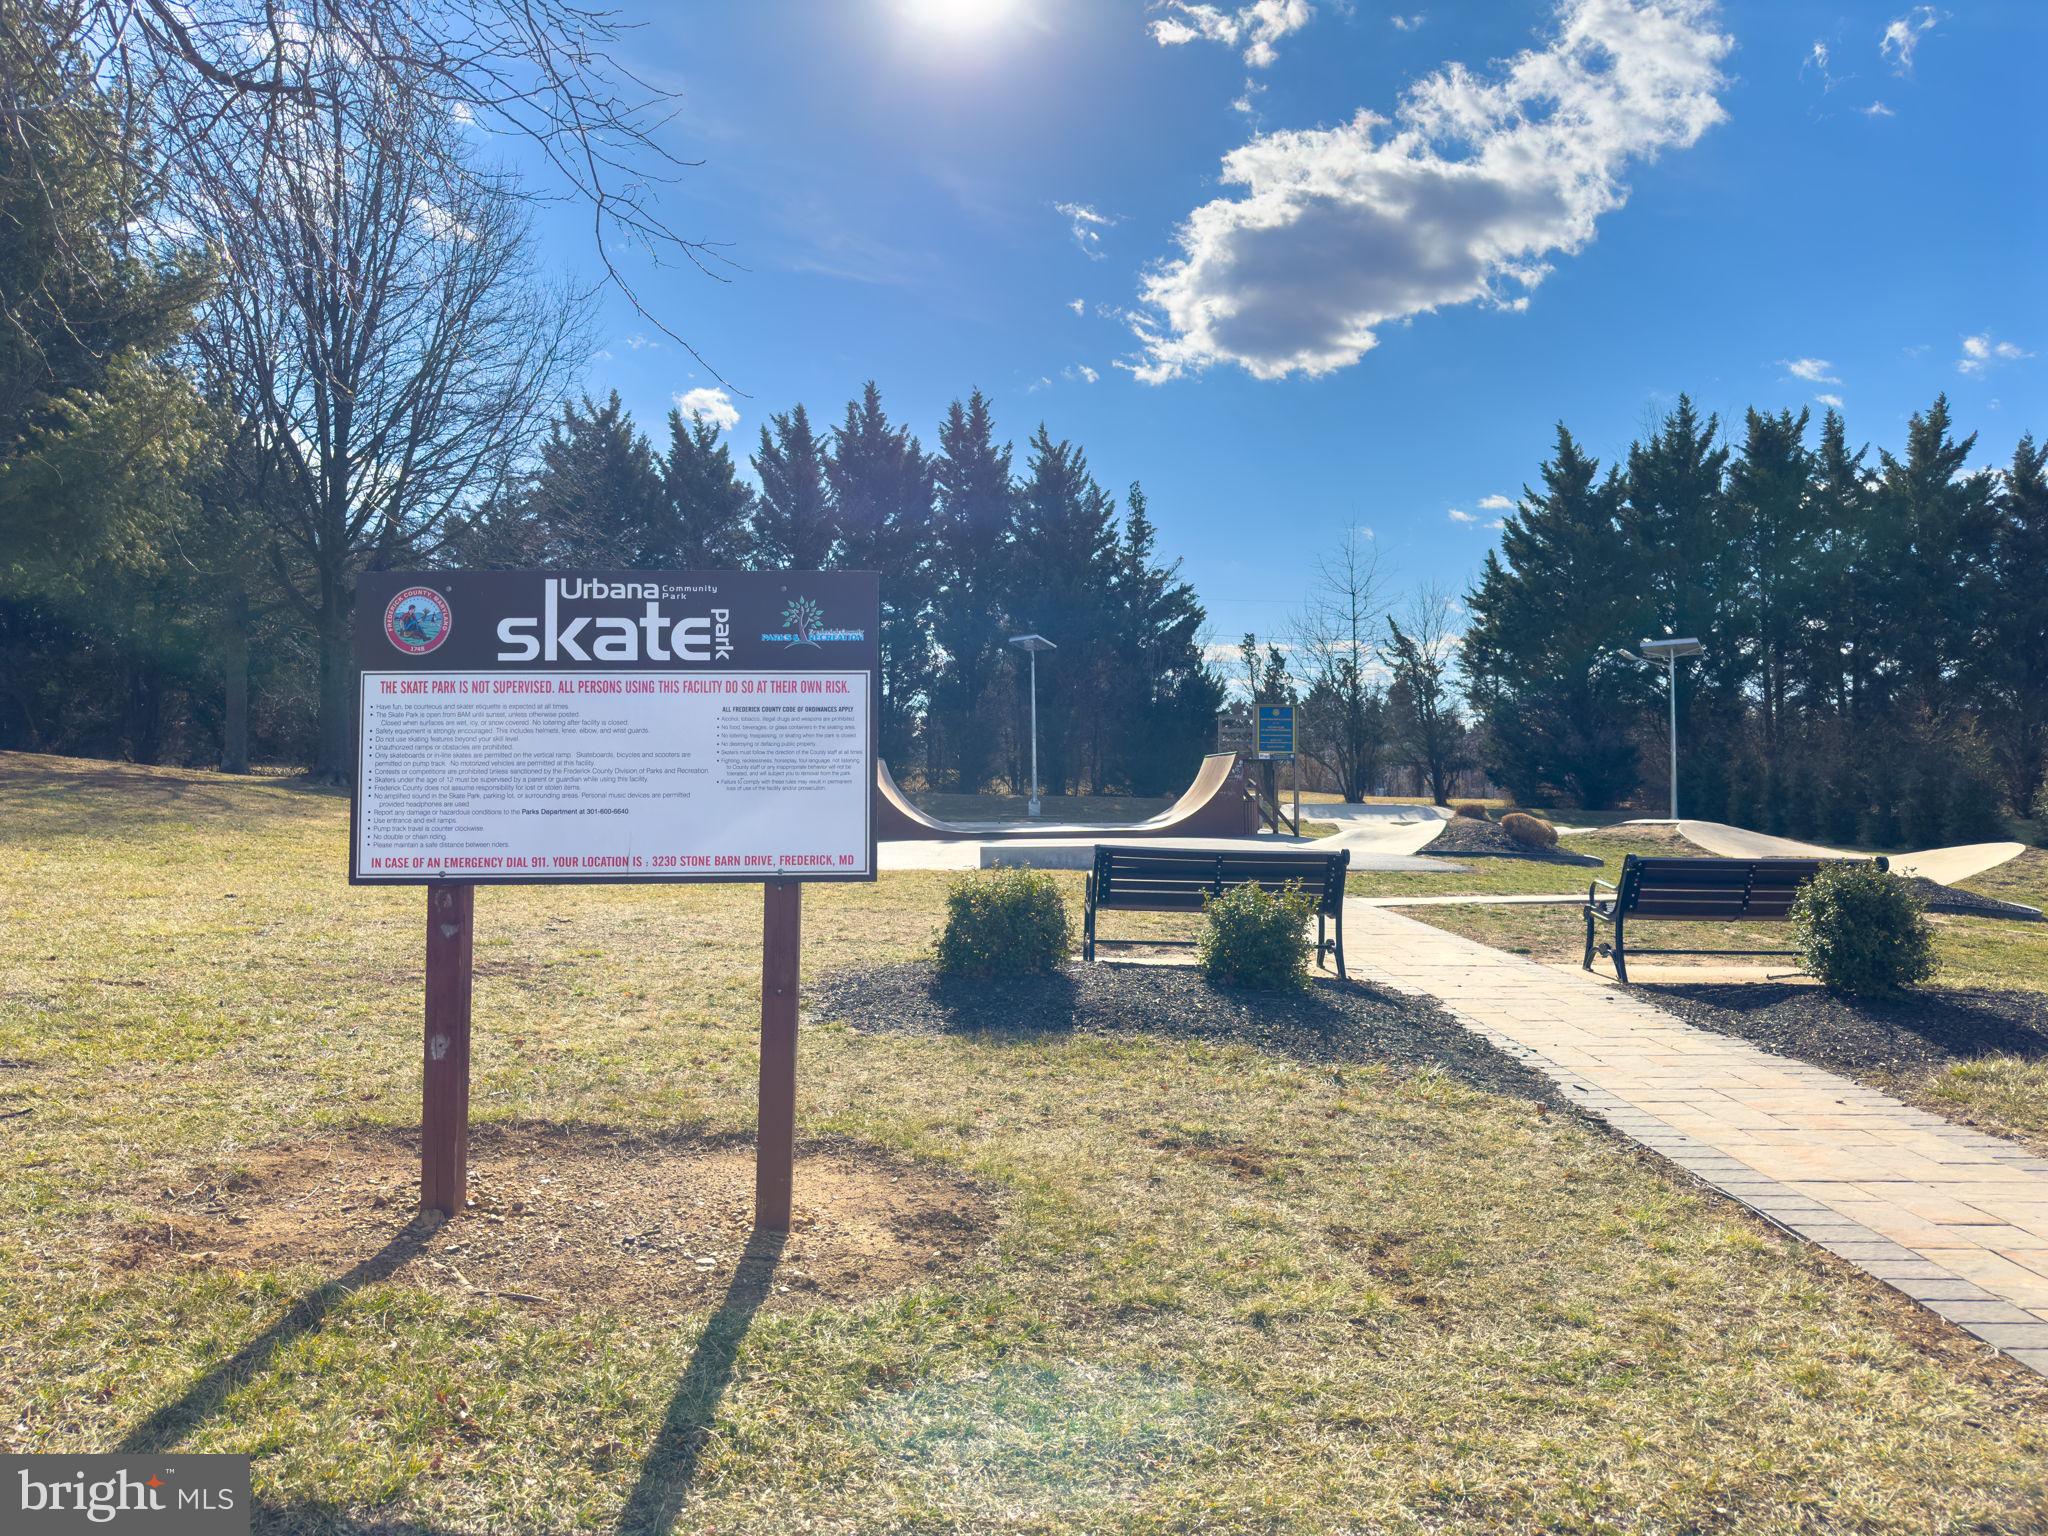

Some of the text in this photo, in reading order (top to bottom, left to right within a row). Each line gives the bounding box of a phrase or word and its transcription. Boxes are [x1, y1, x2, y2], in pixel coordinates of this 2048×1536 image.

[561, 578, 660, 599] Urbana
[662, 584, 718, 593] Community
[497, 578, 711, 661] skate
[710, 608, 734, 660] park
[380, 680, 850, 694] THE SKATE PARK IS NOT SUPERVISED. ALL PERSONS USING THIS FACILITY DO SO AT THEIR OWN RISK.
[540, 808, 577, 817] Department
[371, 858, 381, 868] IN
[385, 857, 409, 868] CASE
[413, 857, 424, 868] OF
[427, 857, 440, 868] AN
[444, 857, 503, 868] EMERGENCY
[507, 857, 528, 867] DIAL
[532, 857, 549, 867] 911.
[553, 857, 578, 867] YOUR
[582, 856, 629, 867] LOCATION
[633, 856, 642, 867] IS
[652, 856, 676, 867] 3230
[680, 856, 711, 866] STONE
[715, 856, 740, 866] BARN
[744, 855, 775, 866] DRIVE,
[780, 855, 835, 868] FREDERICK,
[839, 855, 854, 865] MD
